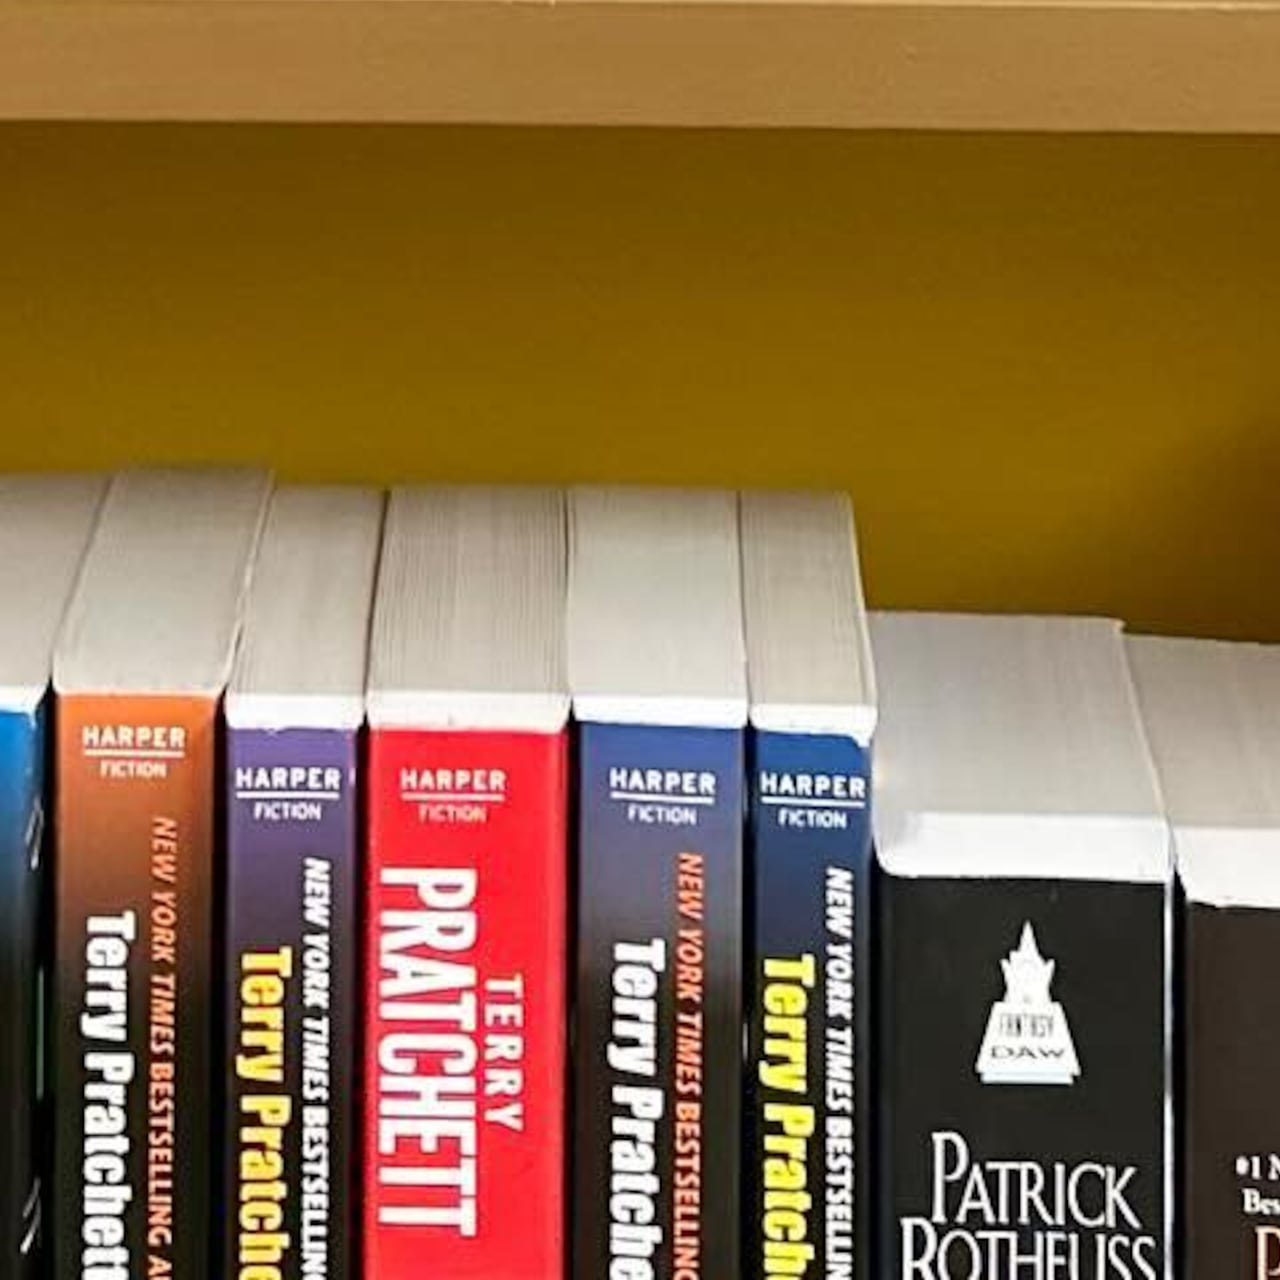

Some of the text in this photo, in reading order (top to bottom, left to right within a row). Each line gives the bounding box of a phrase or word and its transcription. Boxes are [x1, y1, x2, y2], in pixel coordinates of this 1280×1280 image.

[81, 724, 186, 750] HARPER
[99, 760, 167, 779] FICTION
[235, 766, 341, 791] HARPER
[400, 767, 506, 792] HARPER
[609, 766, 716, 795] HARPER
[760, 770, 867, 799] HARPER
[253, 801, 322, 821] FICTION
[419, 804, 487, 823] FICTION
[628, 805, 698, 826] FICTION
[777, 808, 849, 830] FICTION
[151, 816, 178, 886] NEW
[150, 890, 178, 965] YORK
[80, 910, 137, 1043] Terry
[149, 968, 177, 1058] TIMES
[758, 953, 816, 1095] Terry
[376, 866, 478, 1239] PRATCHETT
[484, 971, 524, 1134] TERRY
[989, 1045, 1067, 1061] DAW
[146, 1060, 176, 1250] BESTSELLING
[931, 1131, 1145, 1230] PATRICK
[899, 1216, 1158, 1280] ROTHFUSS
